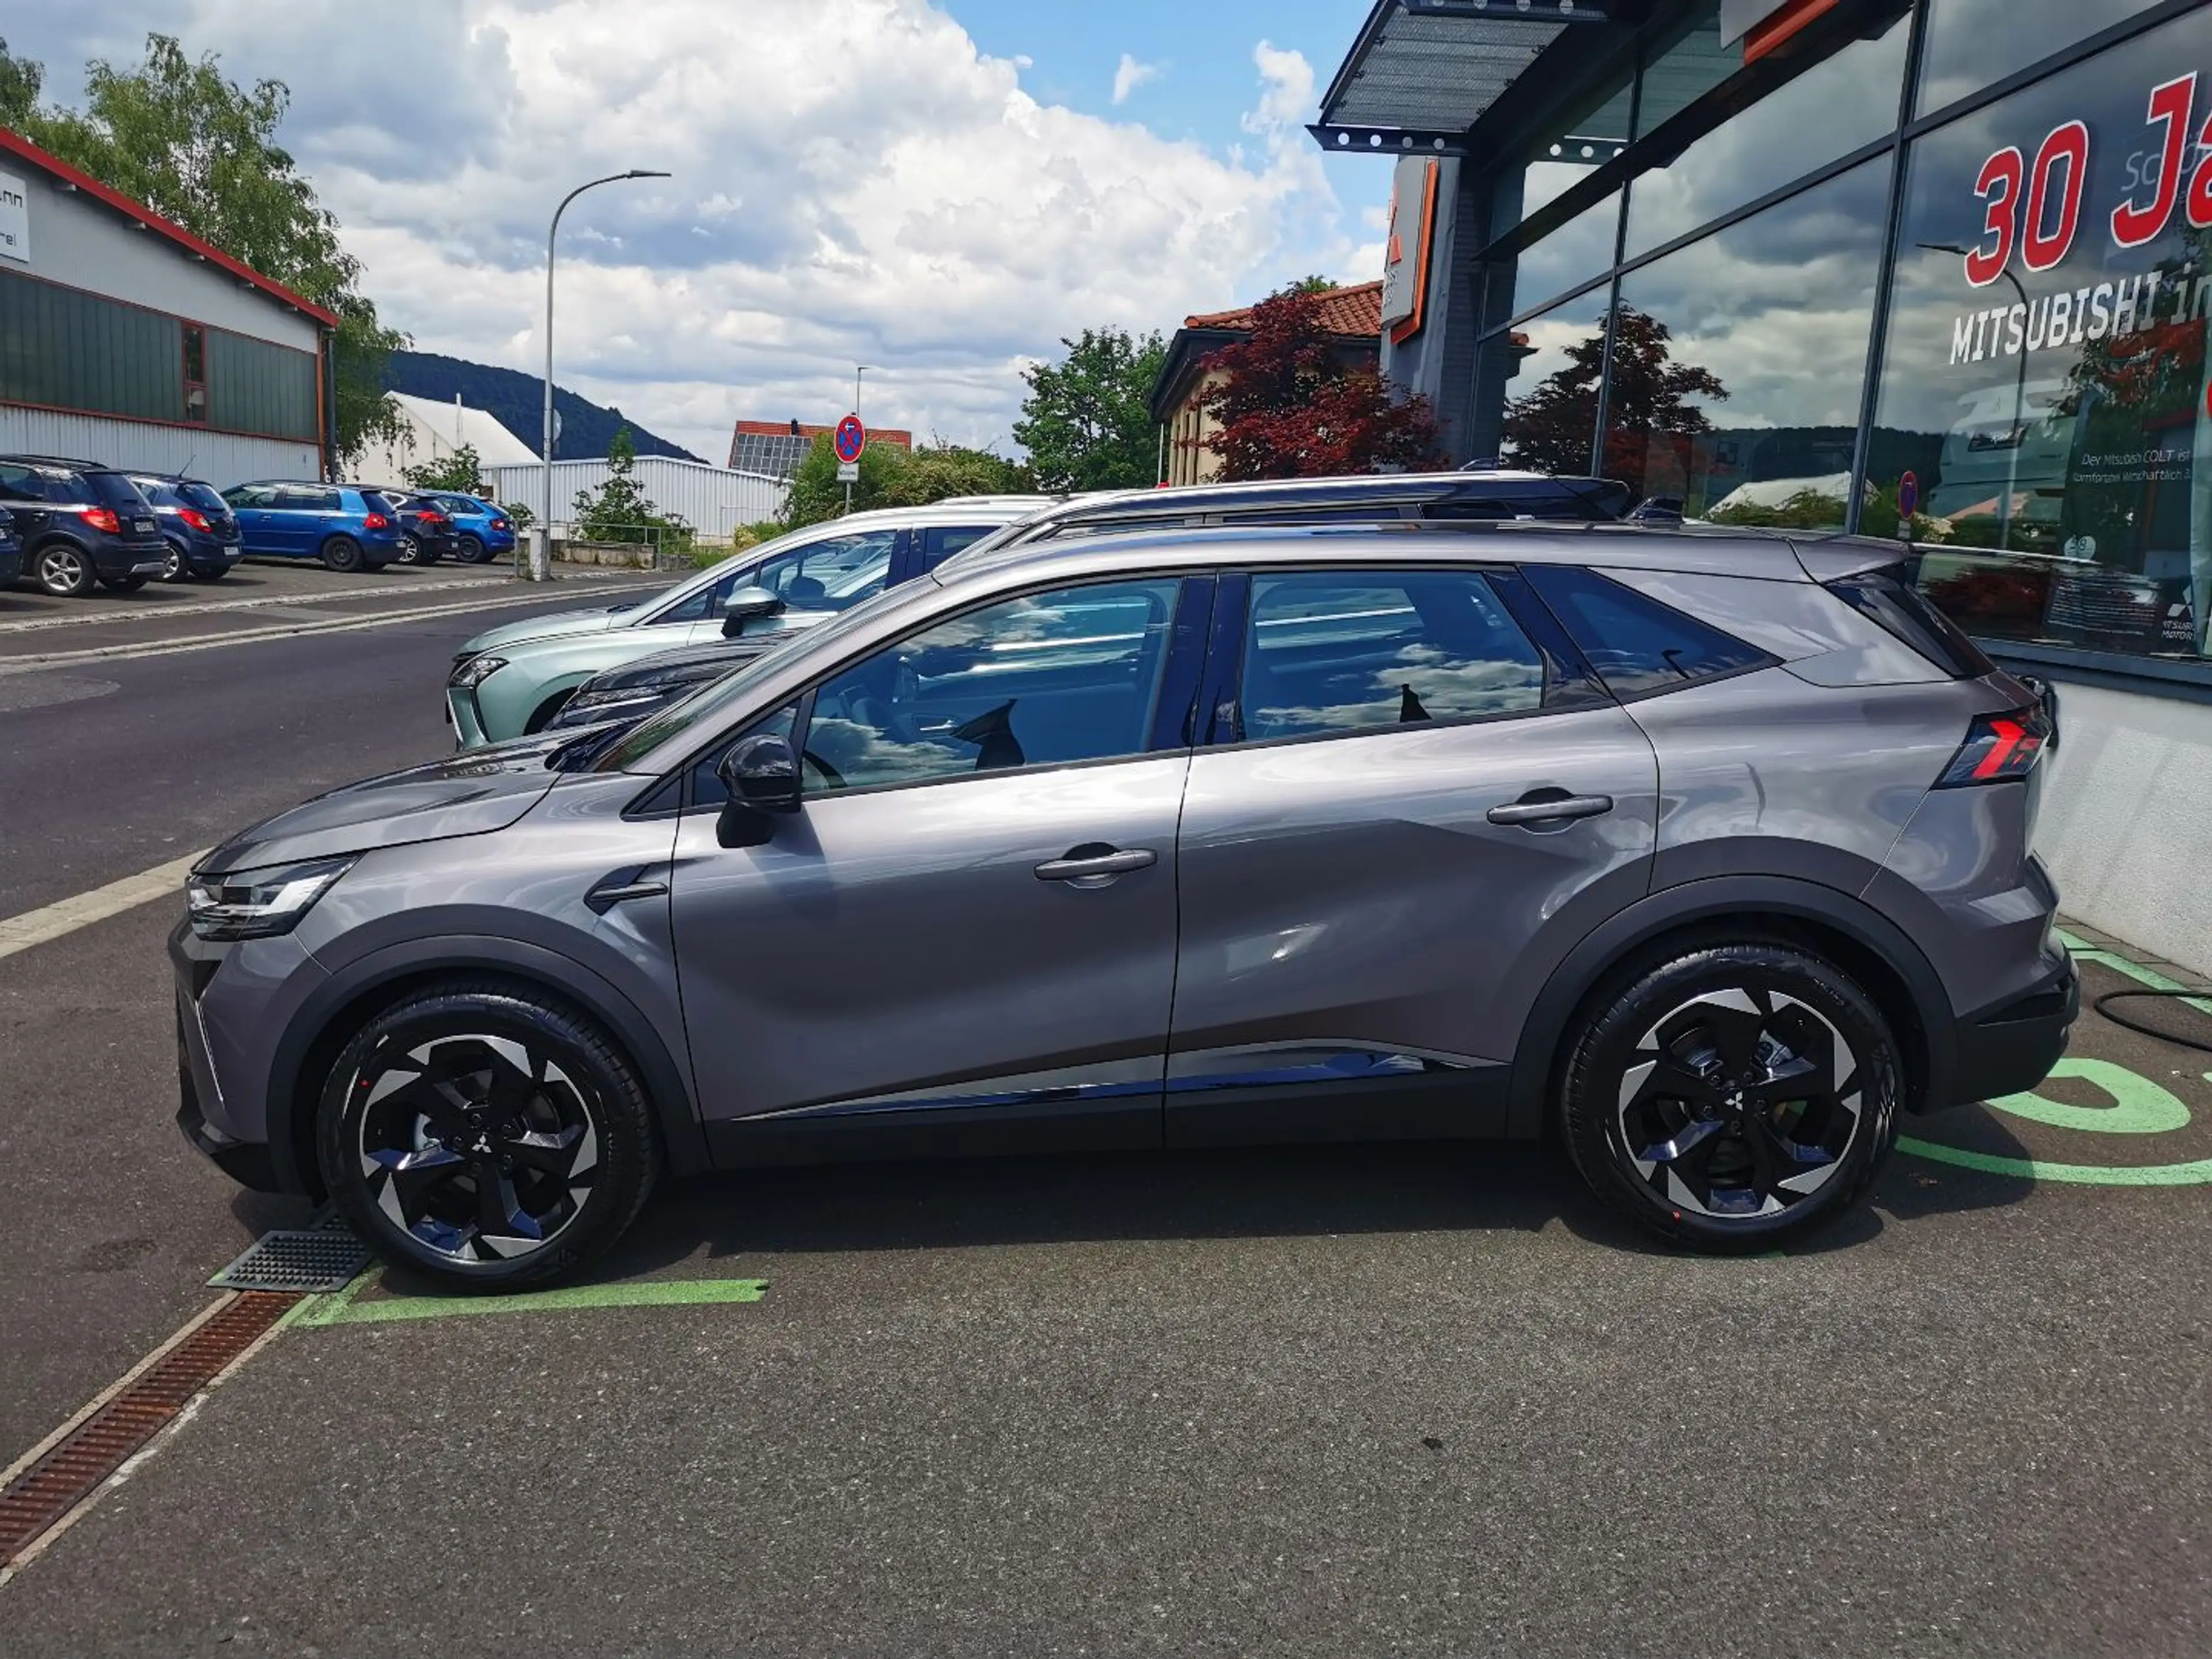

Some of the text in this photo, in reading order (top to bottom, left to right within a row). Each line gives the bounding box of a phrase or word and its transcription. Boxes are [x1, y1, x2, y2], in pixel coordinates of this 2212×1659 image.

[1964, 119, 2089, 287] 30
[1949, 270, 2162, 365] MITSUBISHI
[2081, 453, 2102, 466] Der
[2143, 449, 2175, 463] COLT
